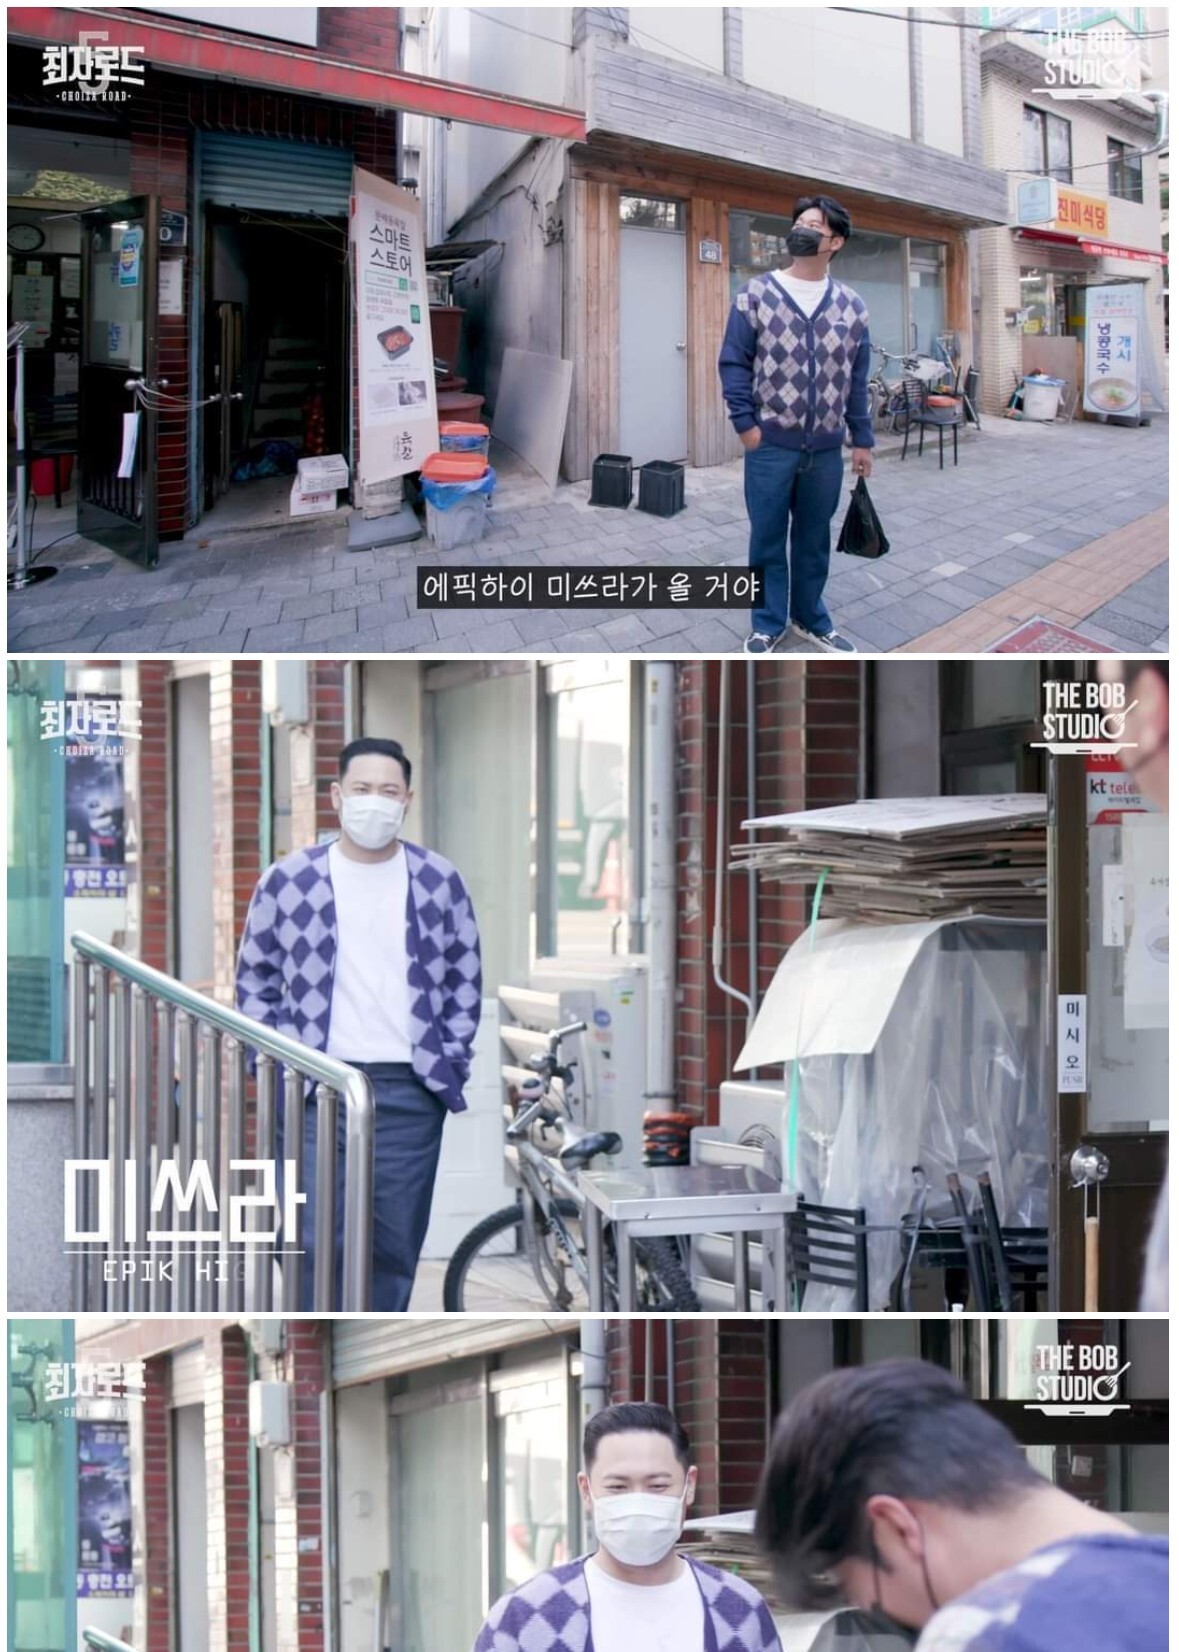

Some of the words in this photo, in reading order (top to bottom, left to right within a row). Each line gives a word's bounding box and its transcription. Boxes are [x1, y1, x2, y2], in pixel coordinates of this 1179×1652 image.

[1058, 197, 1106, 232] 진미식당
[369, 223, 412, 252] 스마트
[369, 247, 412, 278] 스토어
[1090, 779, 1106, 795] kt
[1066, 1001, 1080, 1069] 미시오
